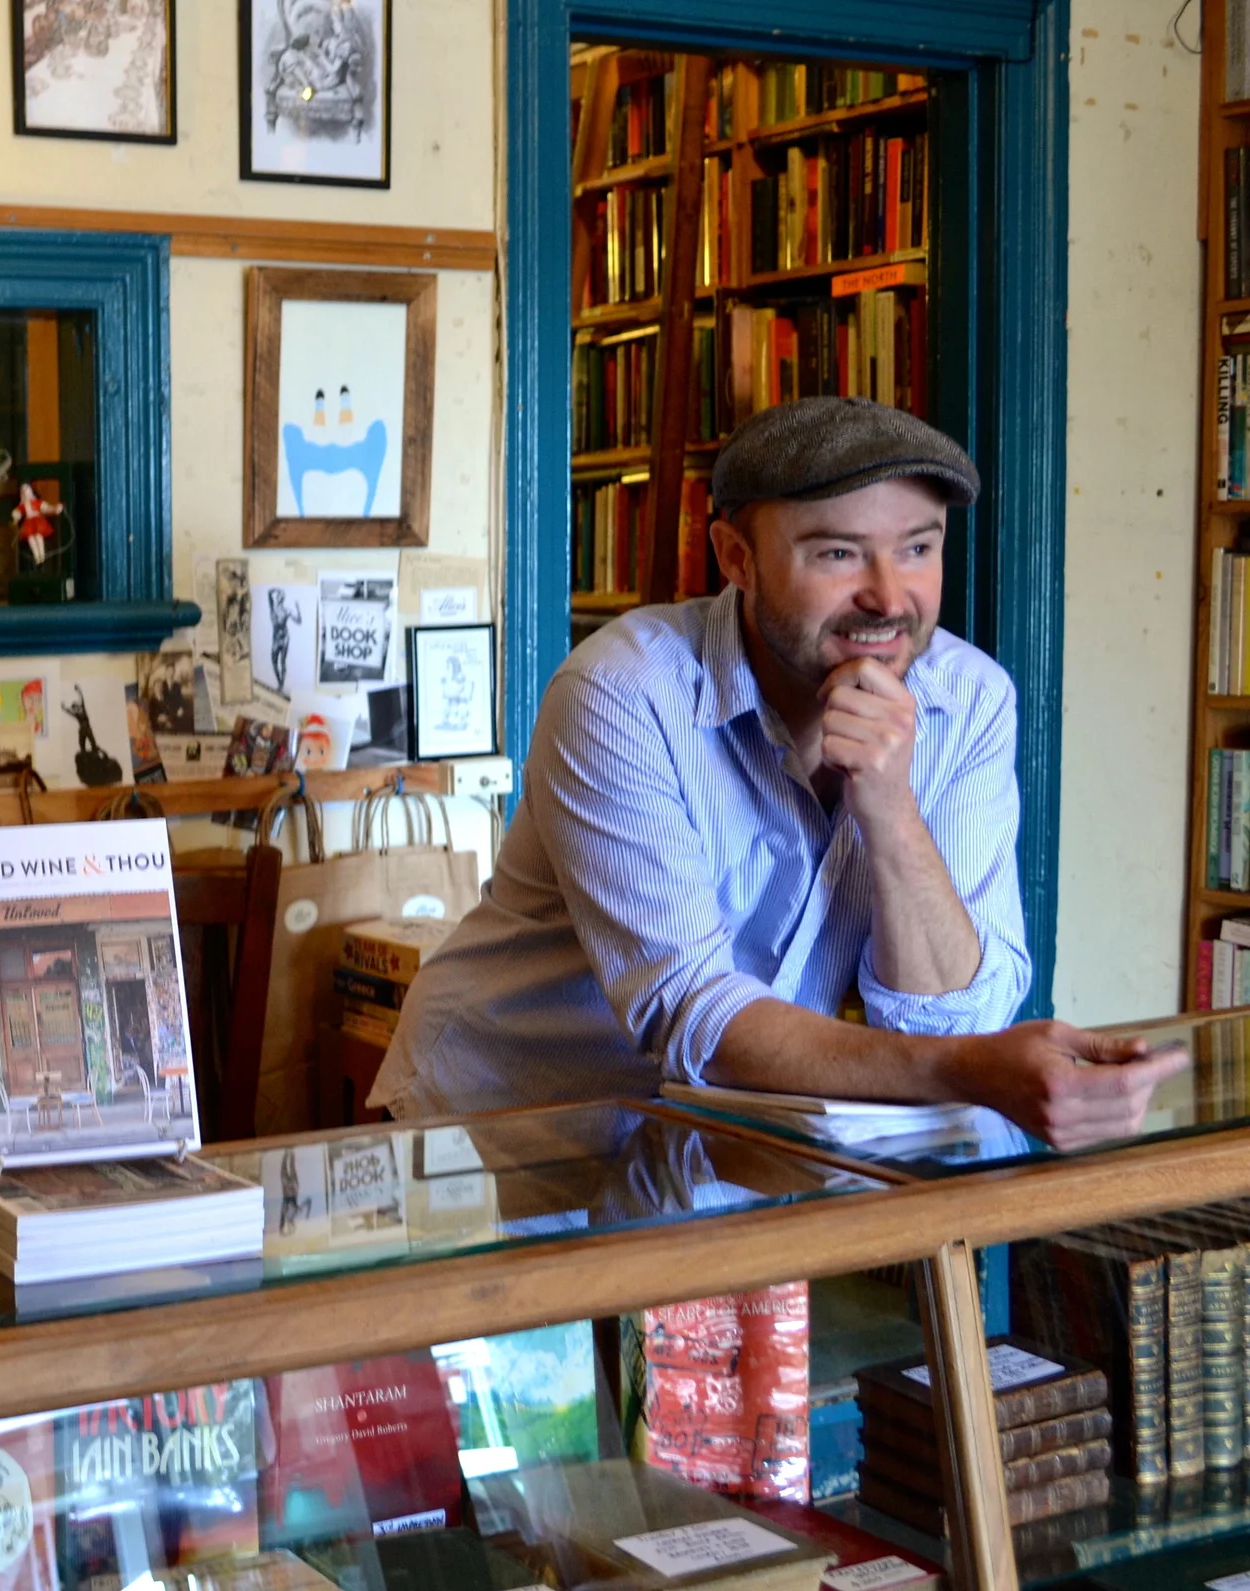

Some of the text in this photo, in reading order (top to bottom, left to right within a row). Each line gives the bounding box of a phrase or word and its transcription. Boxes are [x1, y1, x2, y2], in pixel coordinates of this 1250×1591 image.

[1218, 359, 1229, 424] KILLING
[331, 626, 377, 645] BOOK
[335, 642, 373, 660] SHOP
[20, 856, 78, 877] WINE
[82, 854, 107, 876] &
[105, 852, 166, 873] THOU
[353, 949, 389, 975] RIVALS
[658, 1303, 716, 1322] SEARCH
[740, 1299, 807, 1316] AMERICA
[315, 1384, 407, 1413] SHANTARAM
[315, 1421, 408, 1446] Gregory David Roberts
[73, 1422, 240, 1484] IAIN BANKS
